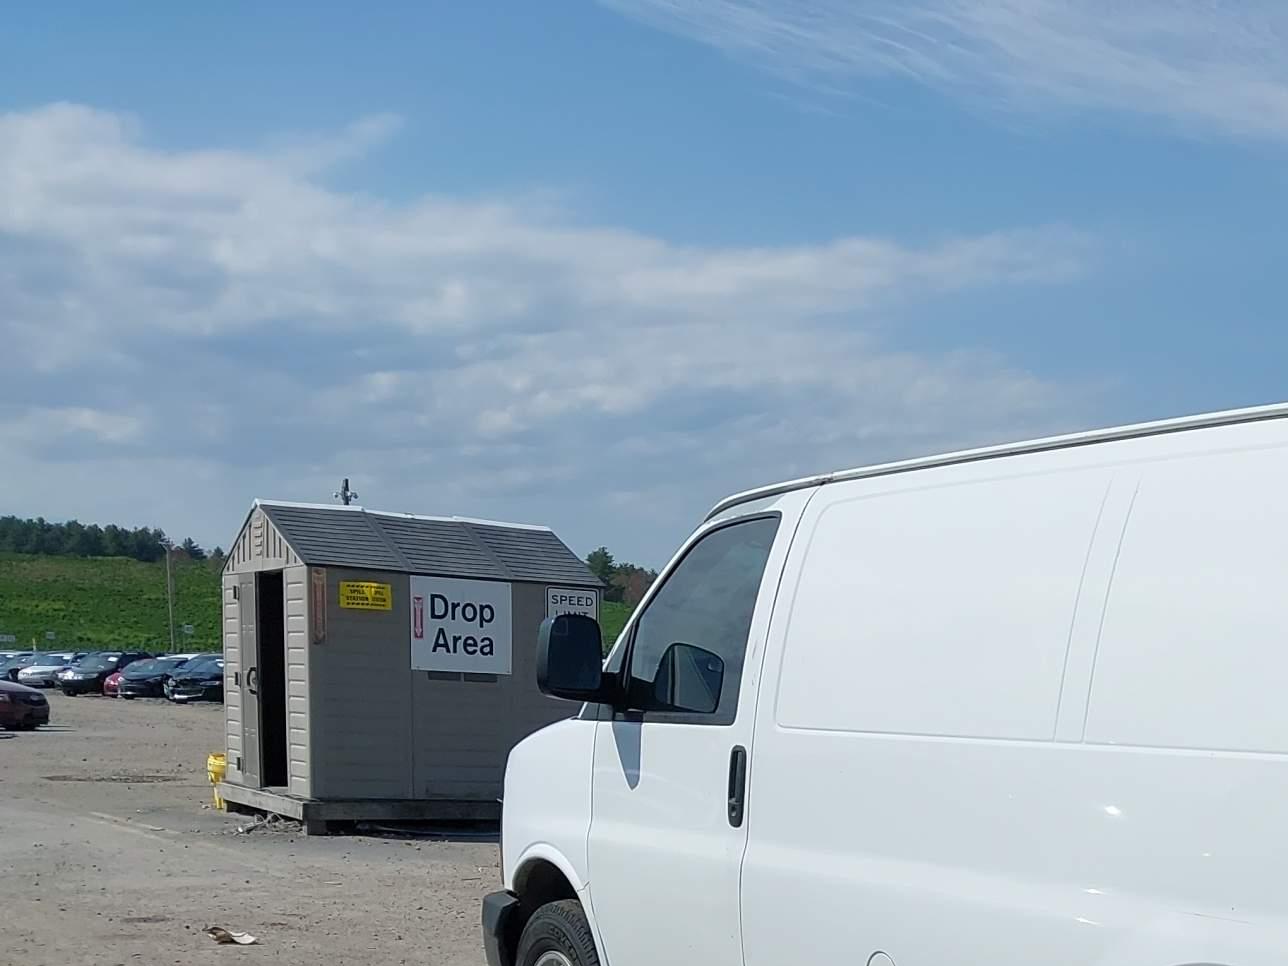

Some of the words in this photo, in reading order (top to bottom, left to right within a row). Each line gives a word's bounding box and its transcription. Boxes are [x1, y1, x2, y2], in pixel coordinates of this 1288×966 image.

[430, 593, 495, 629] Drop
[551, 594, 594, 607] SPEED
[431, 627, 494, 656] Area
